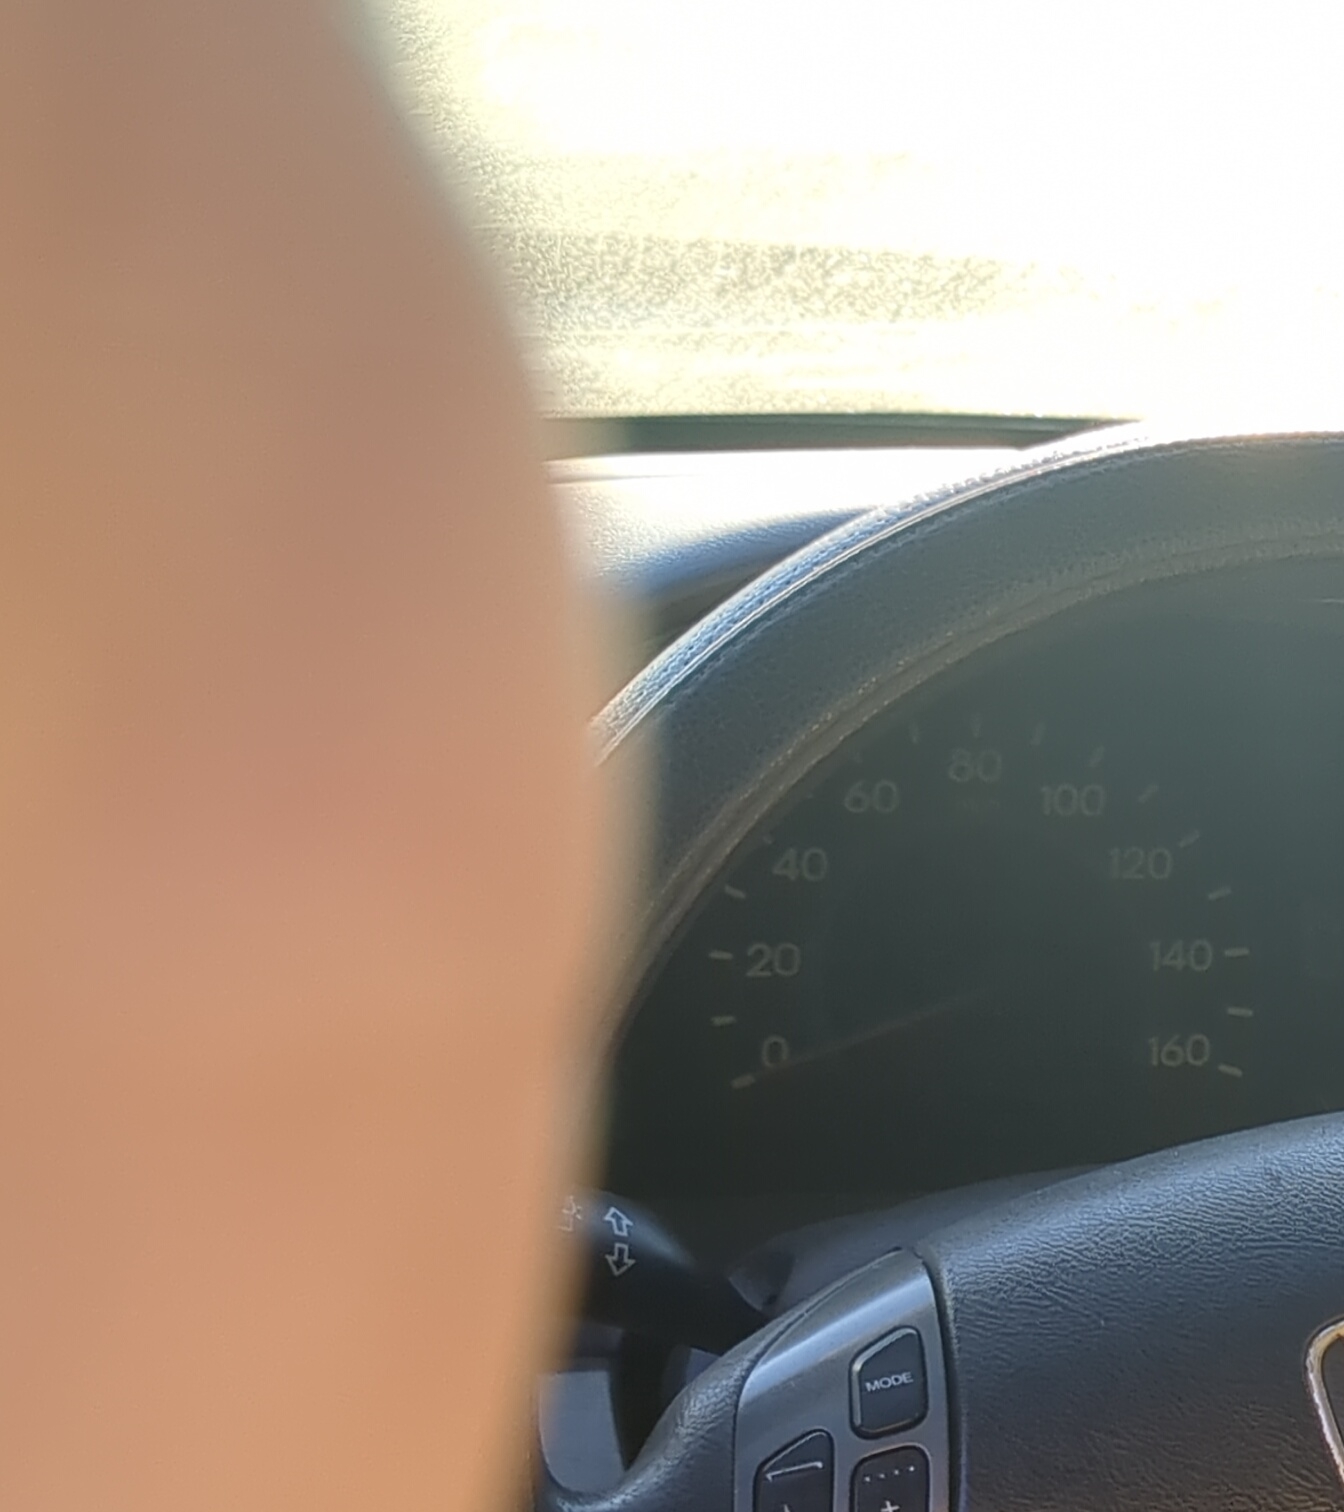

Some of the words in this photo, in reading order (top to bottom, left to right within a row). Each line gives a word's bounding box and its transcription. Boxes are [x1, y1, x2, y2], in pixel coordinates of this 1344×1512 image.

[948, 747, 1003, 783] 80
[842, 780, 897, 815] 60
[1040, 783, 1104, 817] 100
[772, 847, 829, 881] 40
[1107, 847, 1174, 881] 120
[745, 943, 800, 977] 20
[1148, 939, 1213, 972] 140
[761, 1036, 789, 1068] 0
[1147, 1034, 1210, 1067] 160
[865, 1371, 914, 1392] MODE
